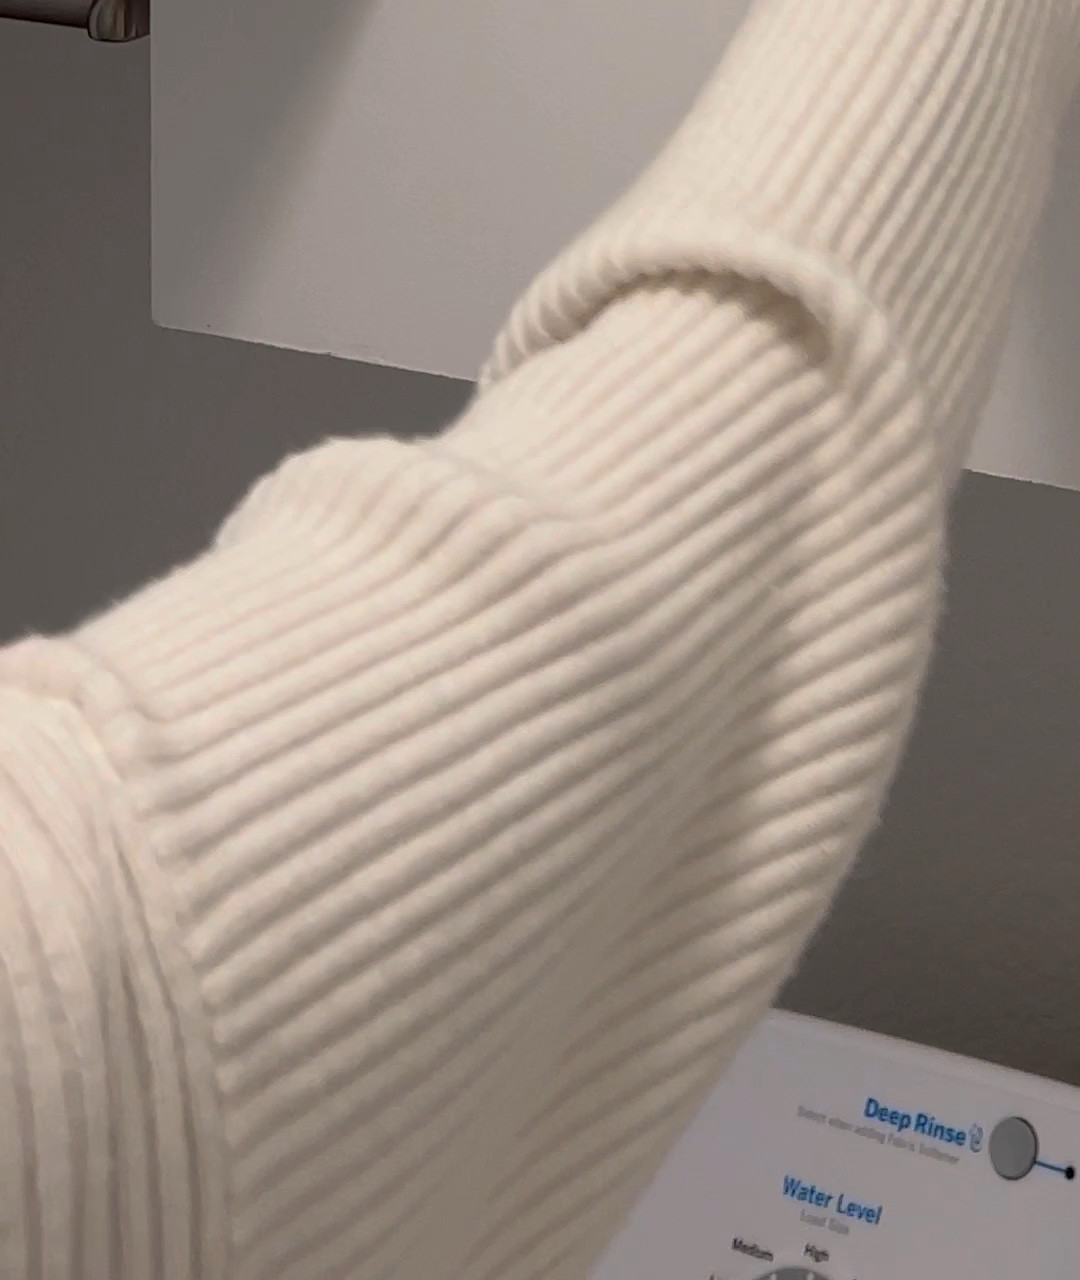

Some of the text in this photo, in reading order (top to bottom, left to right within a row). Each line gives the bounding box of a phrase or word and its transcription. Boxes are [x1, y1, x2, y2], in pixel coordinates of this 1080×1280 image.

[864, 1096, 911, 1132] Deep
[914, 1112, 967, 1146] Rinse
[783, 1174, 834, 1208] Water
[836, 1193, 883, 1225] Level
